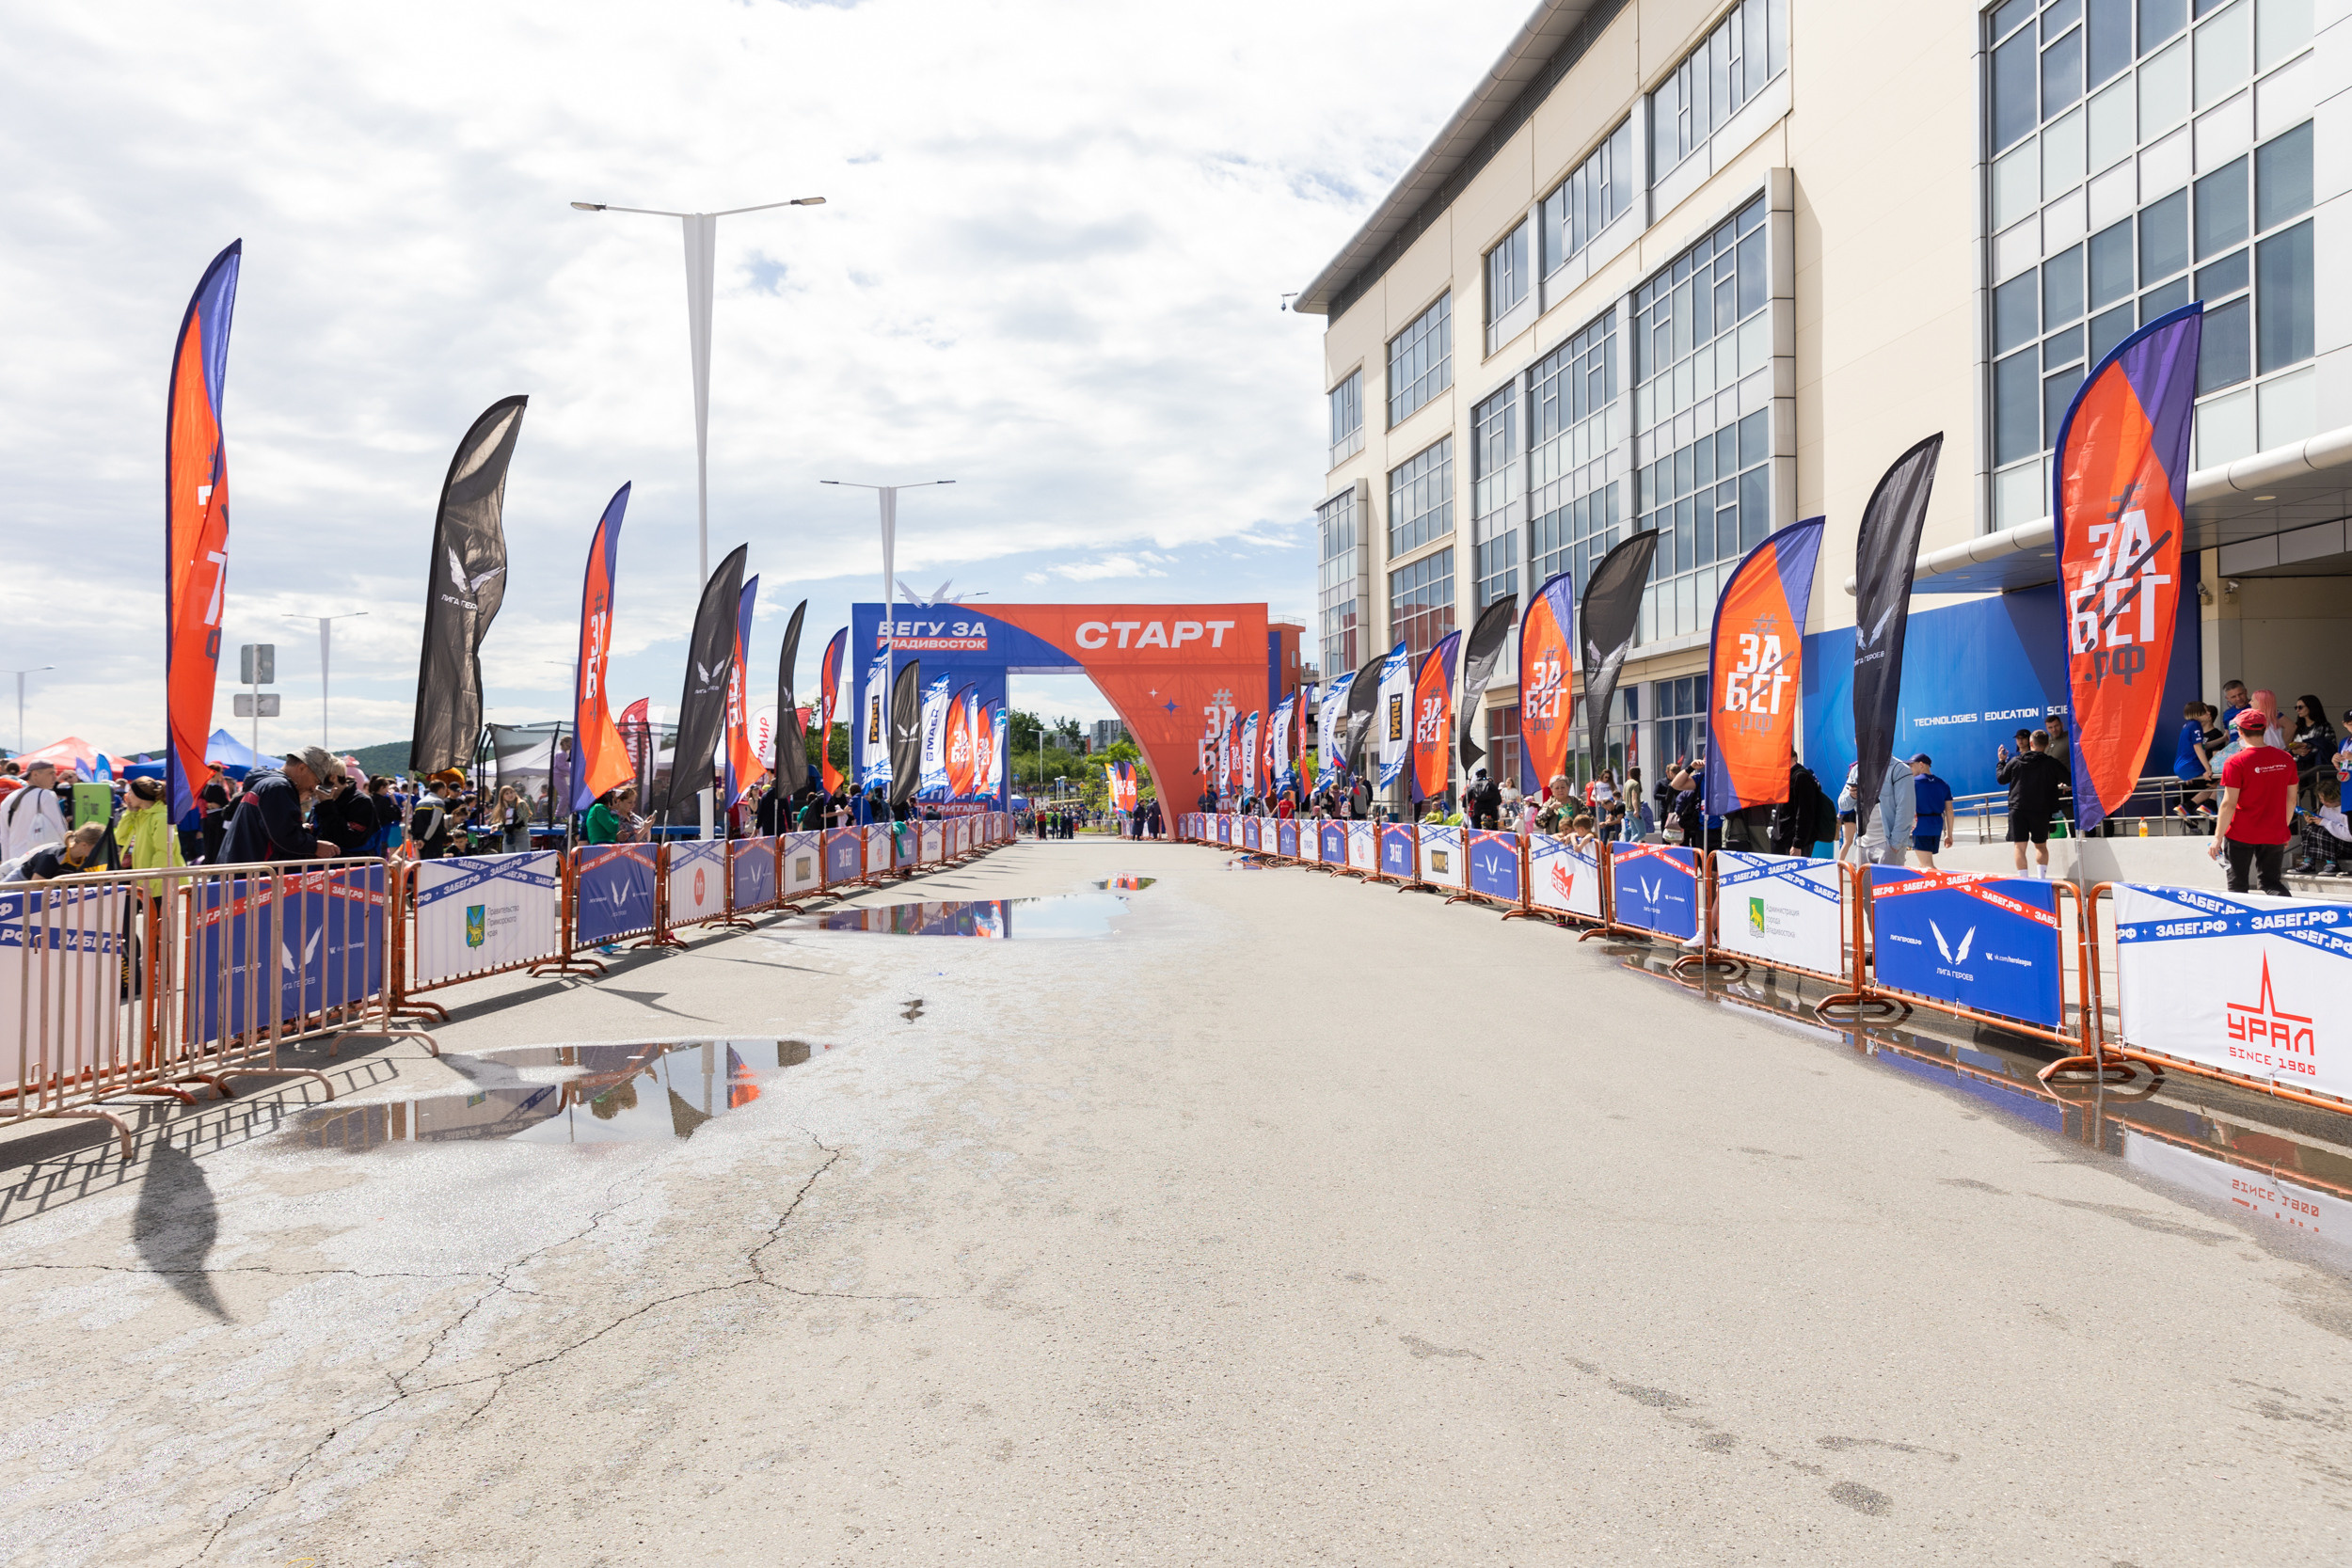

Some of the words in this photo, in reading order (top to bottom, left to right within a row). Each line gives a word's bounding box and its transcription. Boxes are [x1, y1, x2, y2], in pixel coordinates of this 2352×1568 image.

[2081, 509, 2156, 588] ЗА
[2070, 574, 2171, 655] БЕГ
[877, 621, 946, 636] БЕГУ
[951, 622, 987, 637] ЗА
[1075, 621, 1235, 649] СТАРТ
[1737, 633, 1783, 675] ЗА
[1531, 660, 1561, 690] ЗА
[1526, 688, 1567, 719] БЕГ
[1725, 672, 1791, 714] БЕГ
[1422, 697, 1442, 721] ЗА
[1914, 713, 1978, 727] TECHNOLOGIES
[1985, 707, 2039, 721] EDUCATION
[1416, 719, 1446, 744] БЕГ
[443, 874, 481, 895] ЗАБЕГ.РФ
[489, 858, 523, 877] ЗАБЕГ.РФ
[1552, 873, 1568, 899] REX
[1733, 869, 1760, 882] ЗАБЕГ.РФ
[1768, 862, 1798, 875] ЗАБЕГ.РФ
[1903, 879, 1937, 893] ЗАБЕГ.РФ
[1947, 872, 1985, 885] ЗАБЕГ.РФ
[1982, 890, 2022, 912] ЗАБЕГ.РФ
[2155, 919, 2228, 938] ЗАБЕГ.РФ
[2251, 910, 2339, 930] ЗАБЕГ.РФ
[1936, 967, 1951, 977] ЛИГА
[1952, 972, 1974, 982] ГЕРОЕВ
[2227, 1013, 2314, 1056] УРАЛ
[2230, 1046, 2272, 1067] SINCE
[2279, 1058, 2316, 1076] 1900
